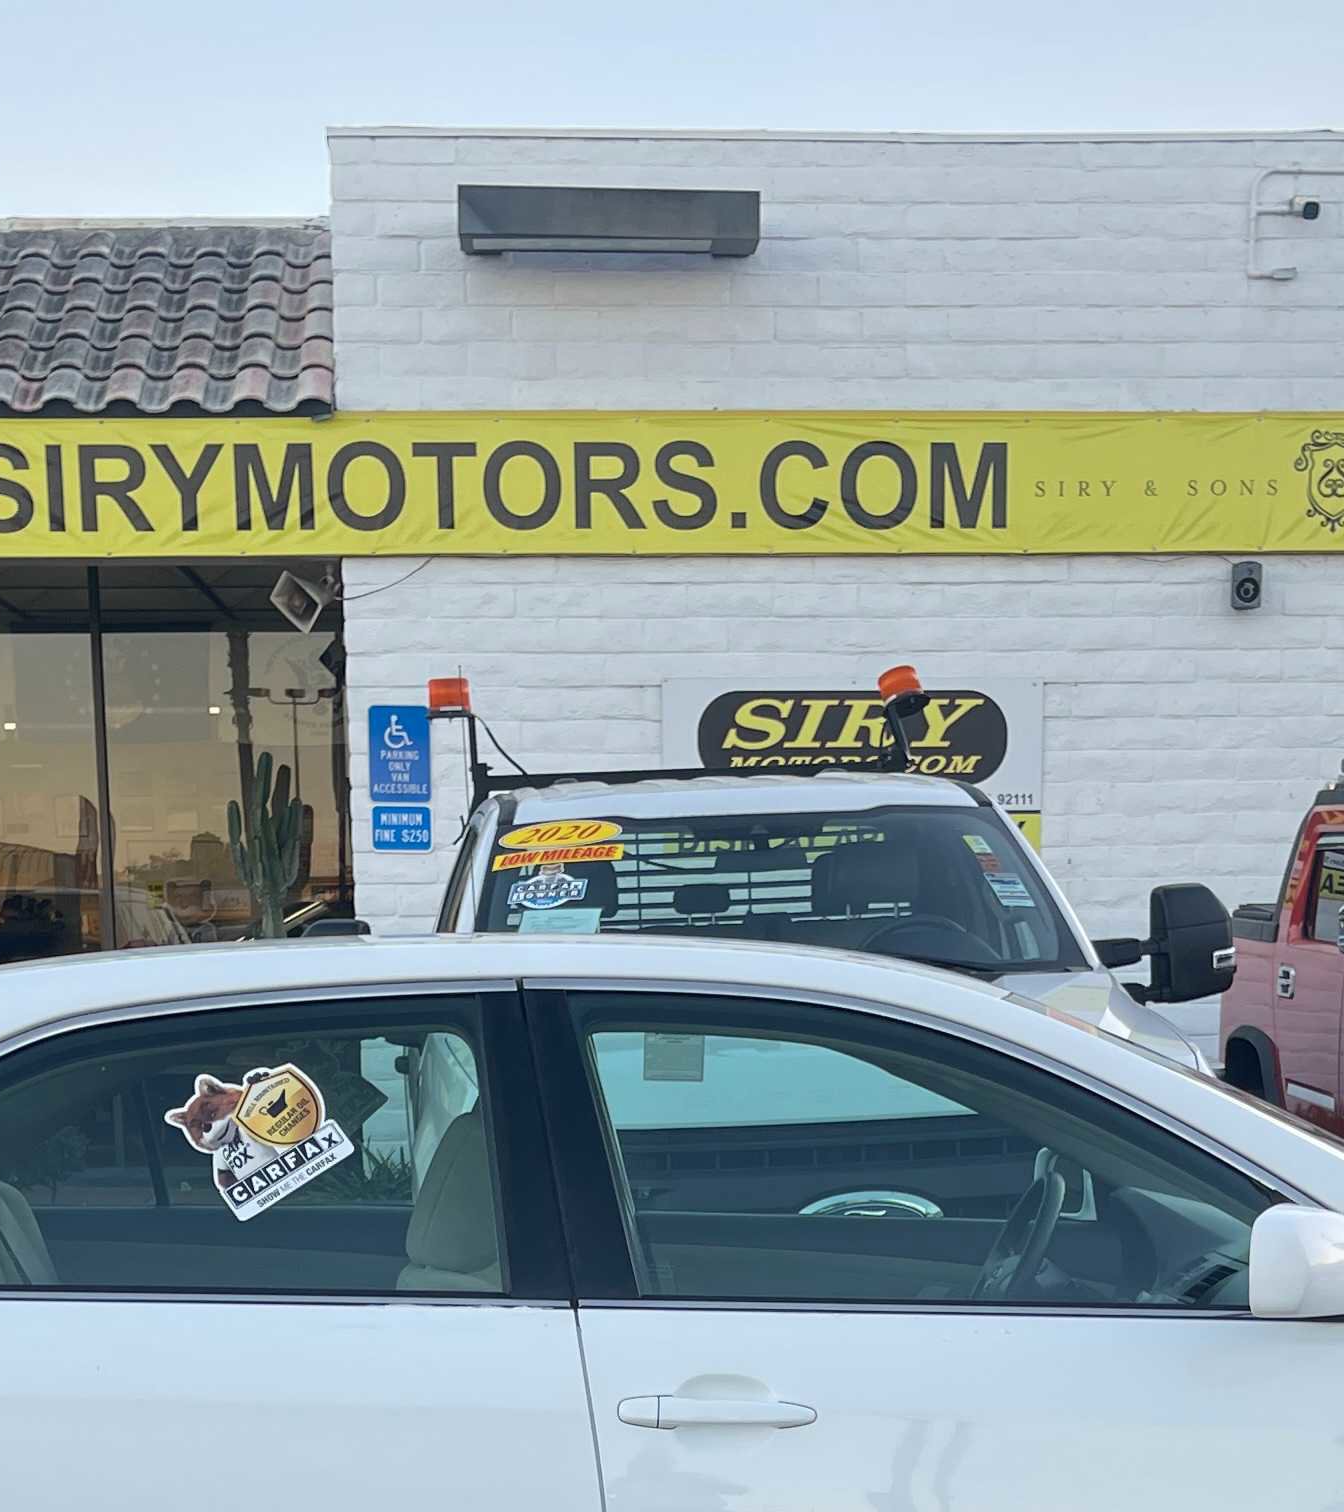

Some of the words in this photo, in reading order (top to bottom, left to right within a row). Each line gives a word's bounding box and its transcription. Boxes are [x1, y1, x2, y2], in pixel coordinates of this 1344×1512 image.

[1033, 478, 1117, 498] SIRY
[1143, 480, 1158, 497] &
[1186, 478, 1282, 498] SONS
[722, 698, 984, 749] SIRY
[380, 750, 419, 760] PARKING
[388, 762, 411, 771] ONLY
[392, 773, 409, 782] VAN
[373, 784, 428, 794] ACCESSIBLE
[997, 793, 1032, 805] 92111
[380, 813, 423, 826] MINIMUM
[375, 829, 396, 842] FINE
[401, 829, 429, 842] $250
[519, 823, 602, 844] 2020
[499, 851, 540, 867] LOW
[540, 845, 618, 863] MILEAGE
[266, 1107, 297, 1137] REGULAR
[278, 1108, 311, 1137] CHANGES
[227, 1146, 254, 1170] FOX
[229, 1132, 339, 1204] CARFAX
[256, 1188, 281, 1208] SHOW
[306, 1153, 336, 1176] CARFAX
